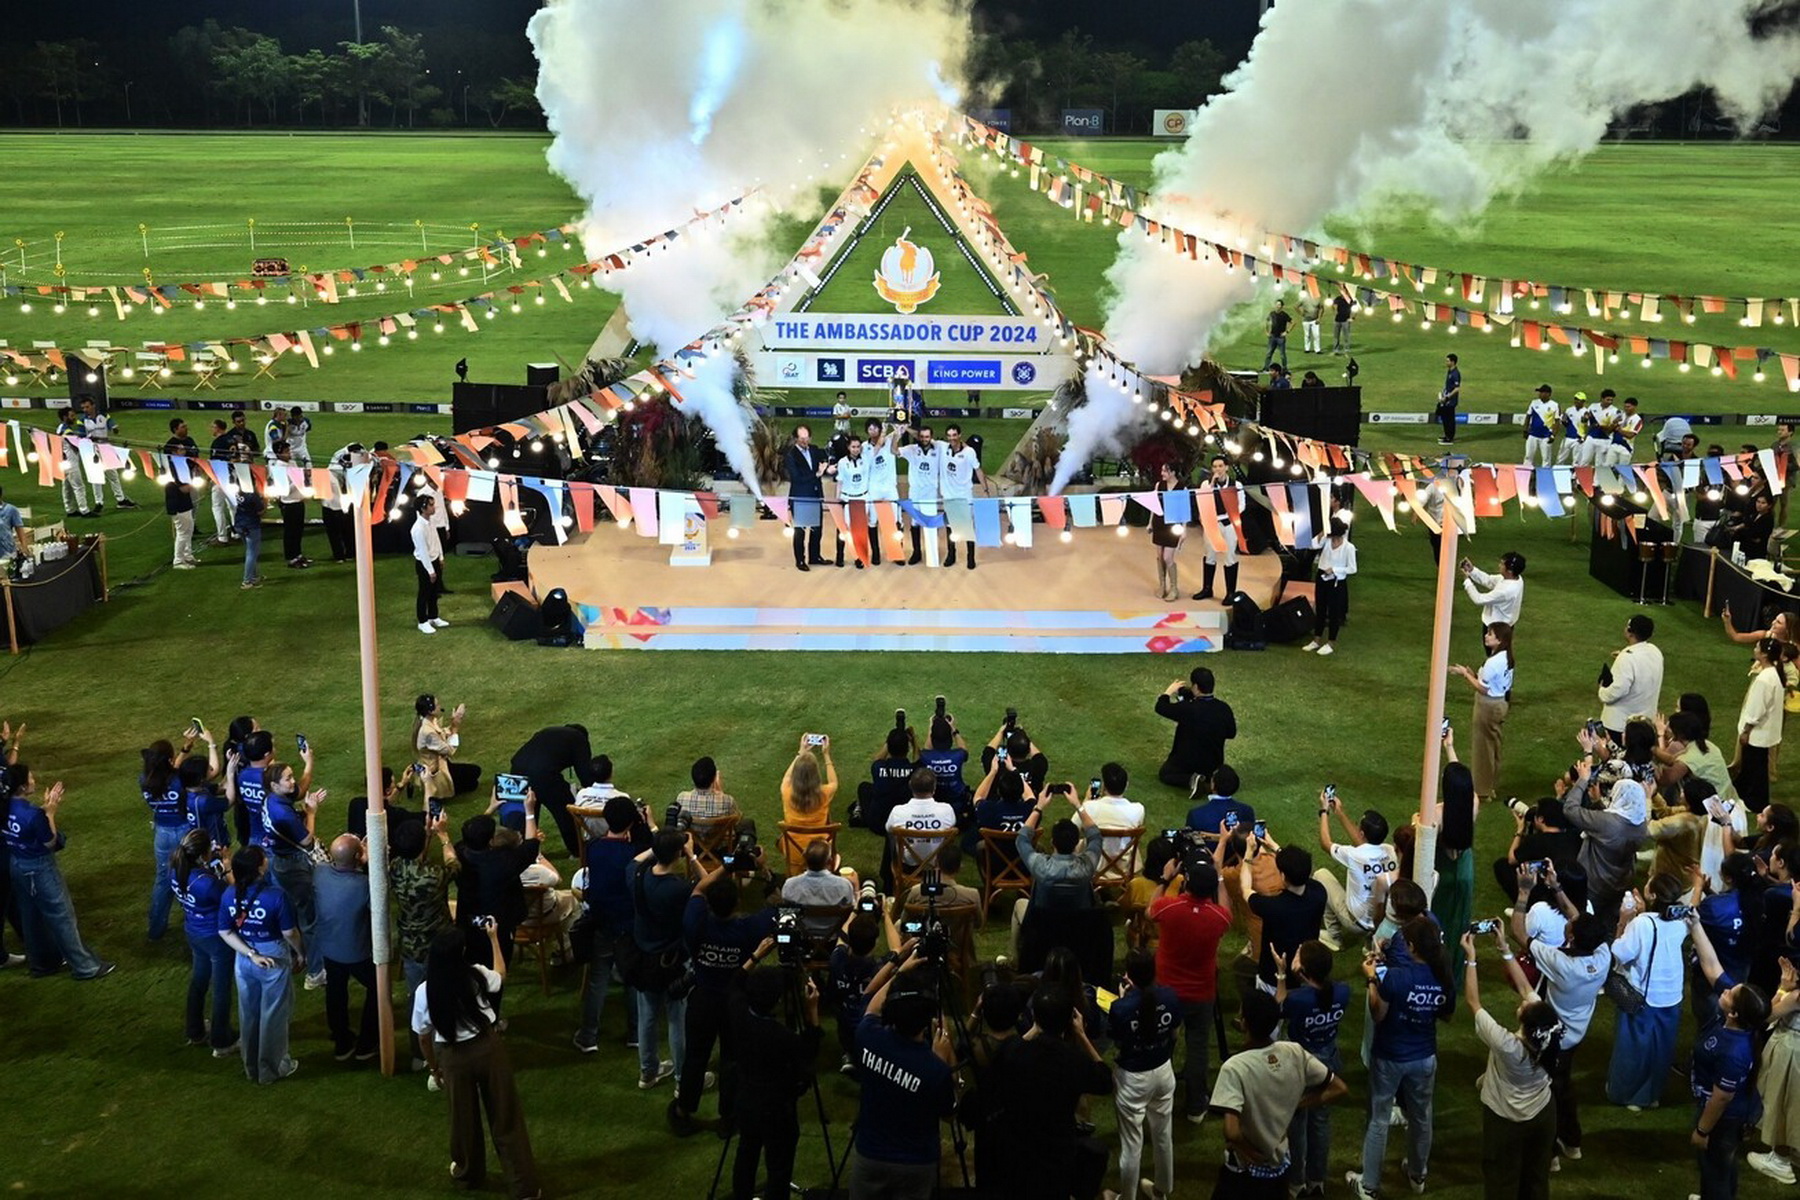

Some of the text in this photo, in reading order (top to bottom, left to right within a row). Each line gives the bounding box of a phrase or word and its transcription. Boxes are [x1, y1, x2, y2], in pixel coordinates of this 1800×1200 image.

[1166, 118, 1183, 129] CP
[775, 322, 1037, 343] THE AMBASSADOR CUP 2024
[933, 369, 996, 379] KING POWER
[905, 819, 942, 830] POLO
[1363, 861, 1397, 874] POLO
[228, 906, 266, 919] PLO
[1305, 1009, 1344, 1028] POLO
[861, 1047, 922, 1093] THAILAND
